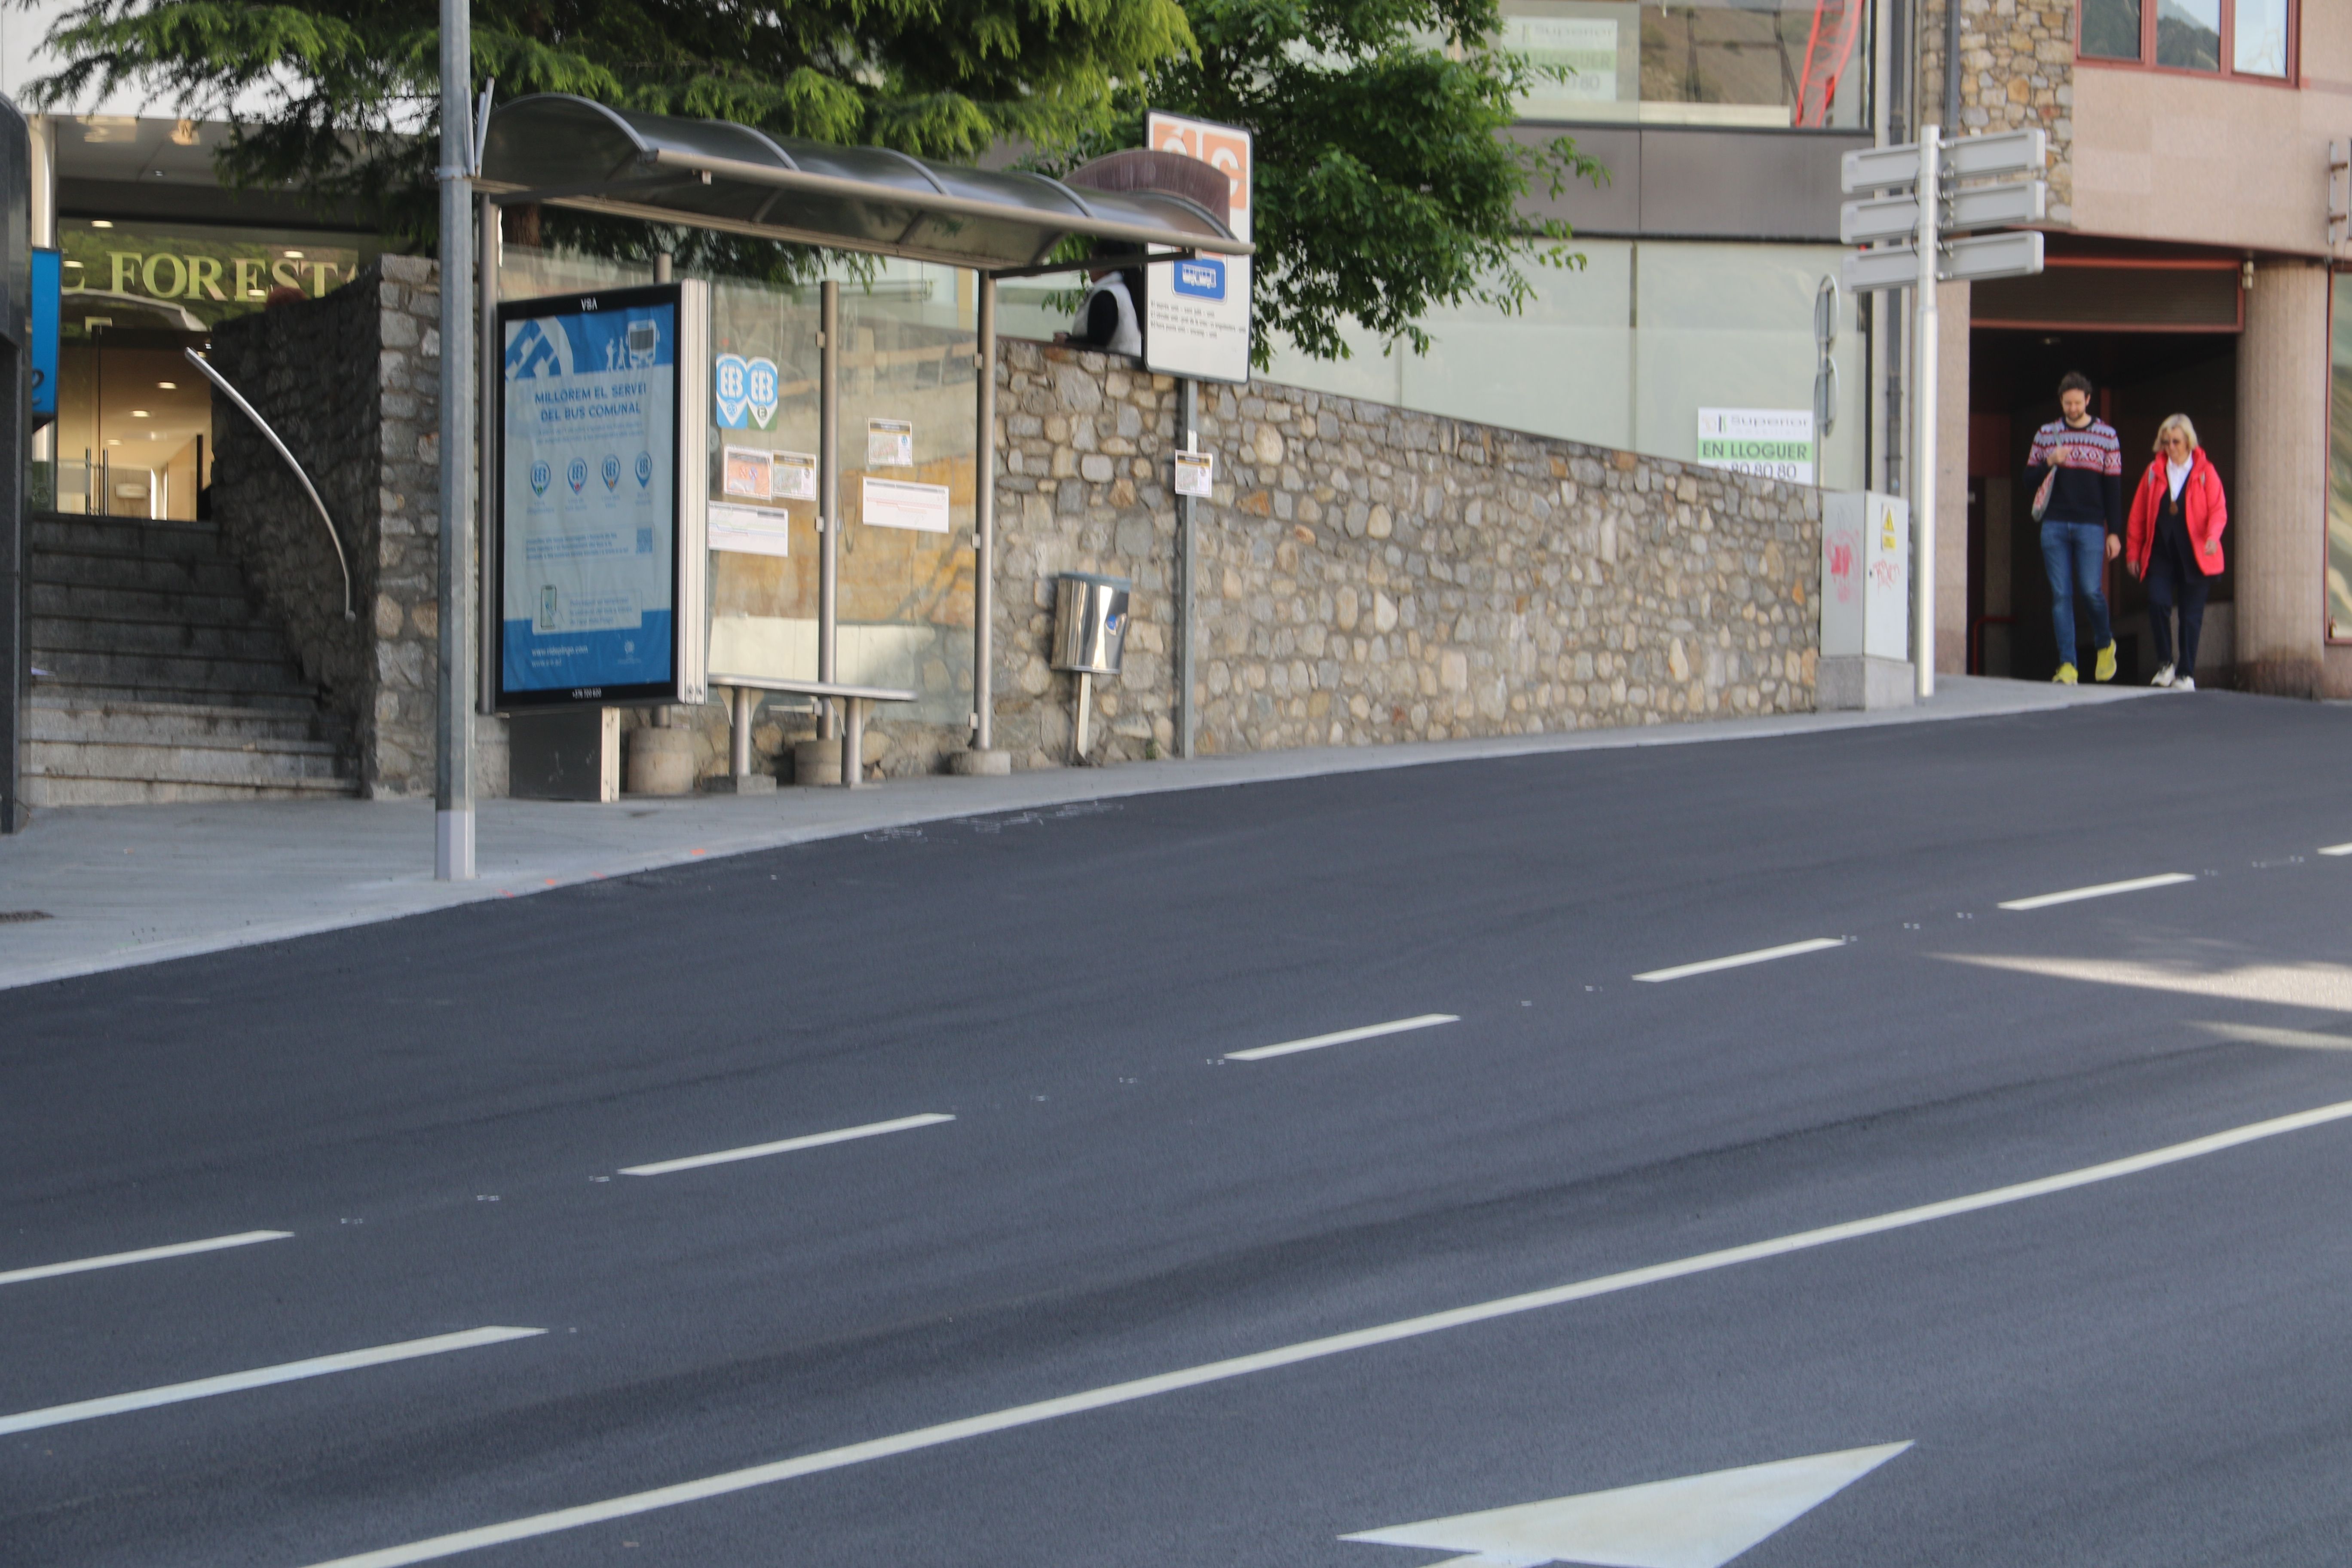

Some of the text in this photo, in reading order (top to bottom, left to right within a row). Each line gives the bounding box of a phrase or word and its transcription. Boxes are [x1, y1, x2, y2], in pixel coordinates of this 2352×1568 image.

[535, 381, 646, 405] MILLOREM EL SERVEI
[540, 401, 641, 423] DEL BUS COMUNAL
[1703, 441, 1807, 460] EN LLOGUER
[1778, 462, 1797, 481] 80
